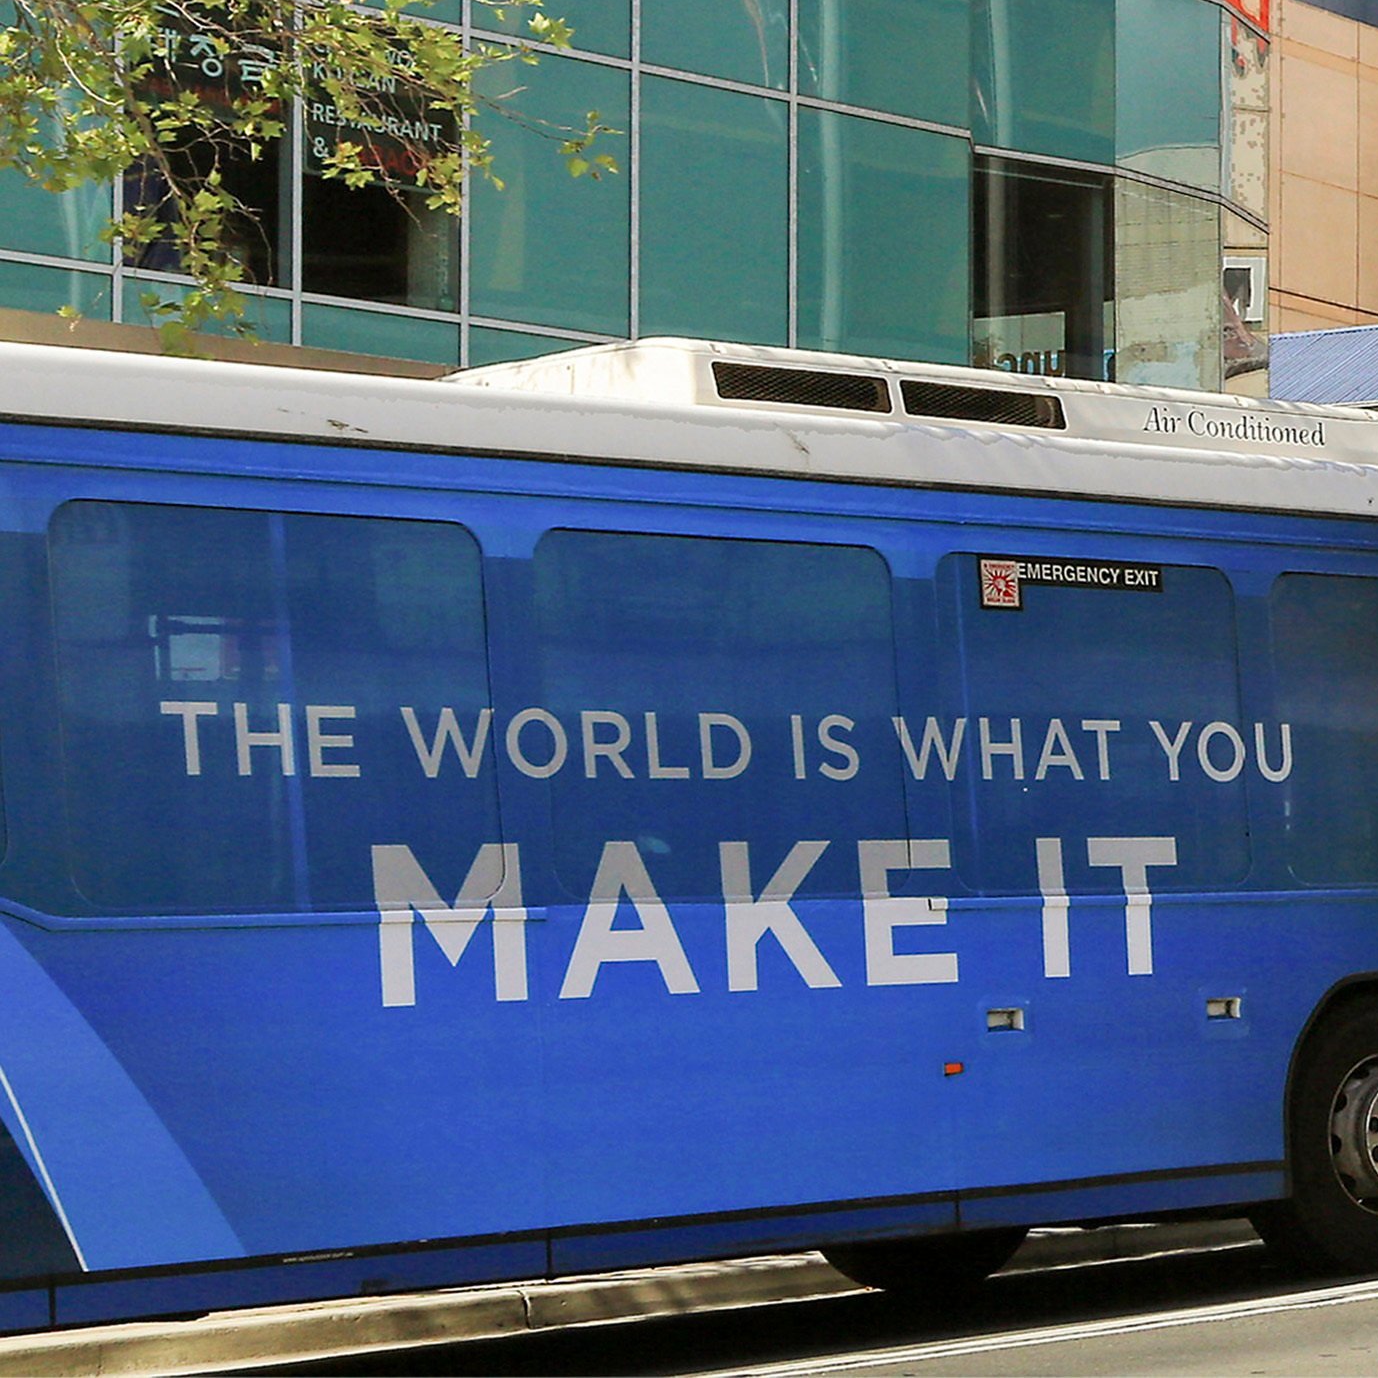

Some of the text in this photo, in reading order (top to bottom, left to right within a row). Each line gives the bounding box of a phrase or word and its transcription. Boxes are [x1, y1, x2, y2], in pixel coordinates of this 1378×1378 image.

[1143, 407, 1326, 447] Air Conditioned
[1017, 562, 1158, 586] EMERGENCY EXIT
[160, 702, 1293, 783] THE WORLD IS WHAT YOU
[371, 837, 1177, 1006] MAKE IT
